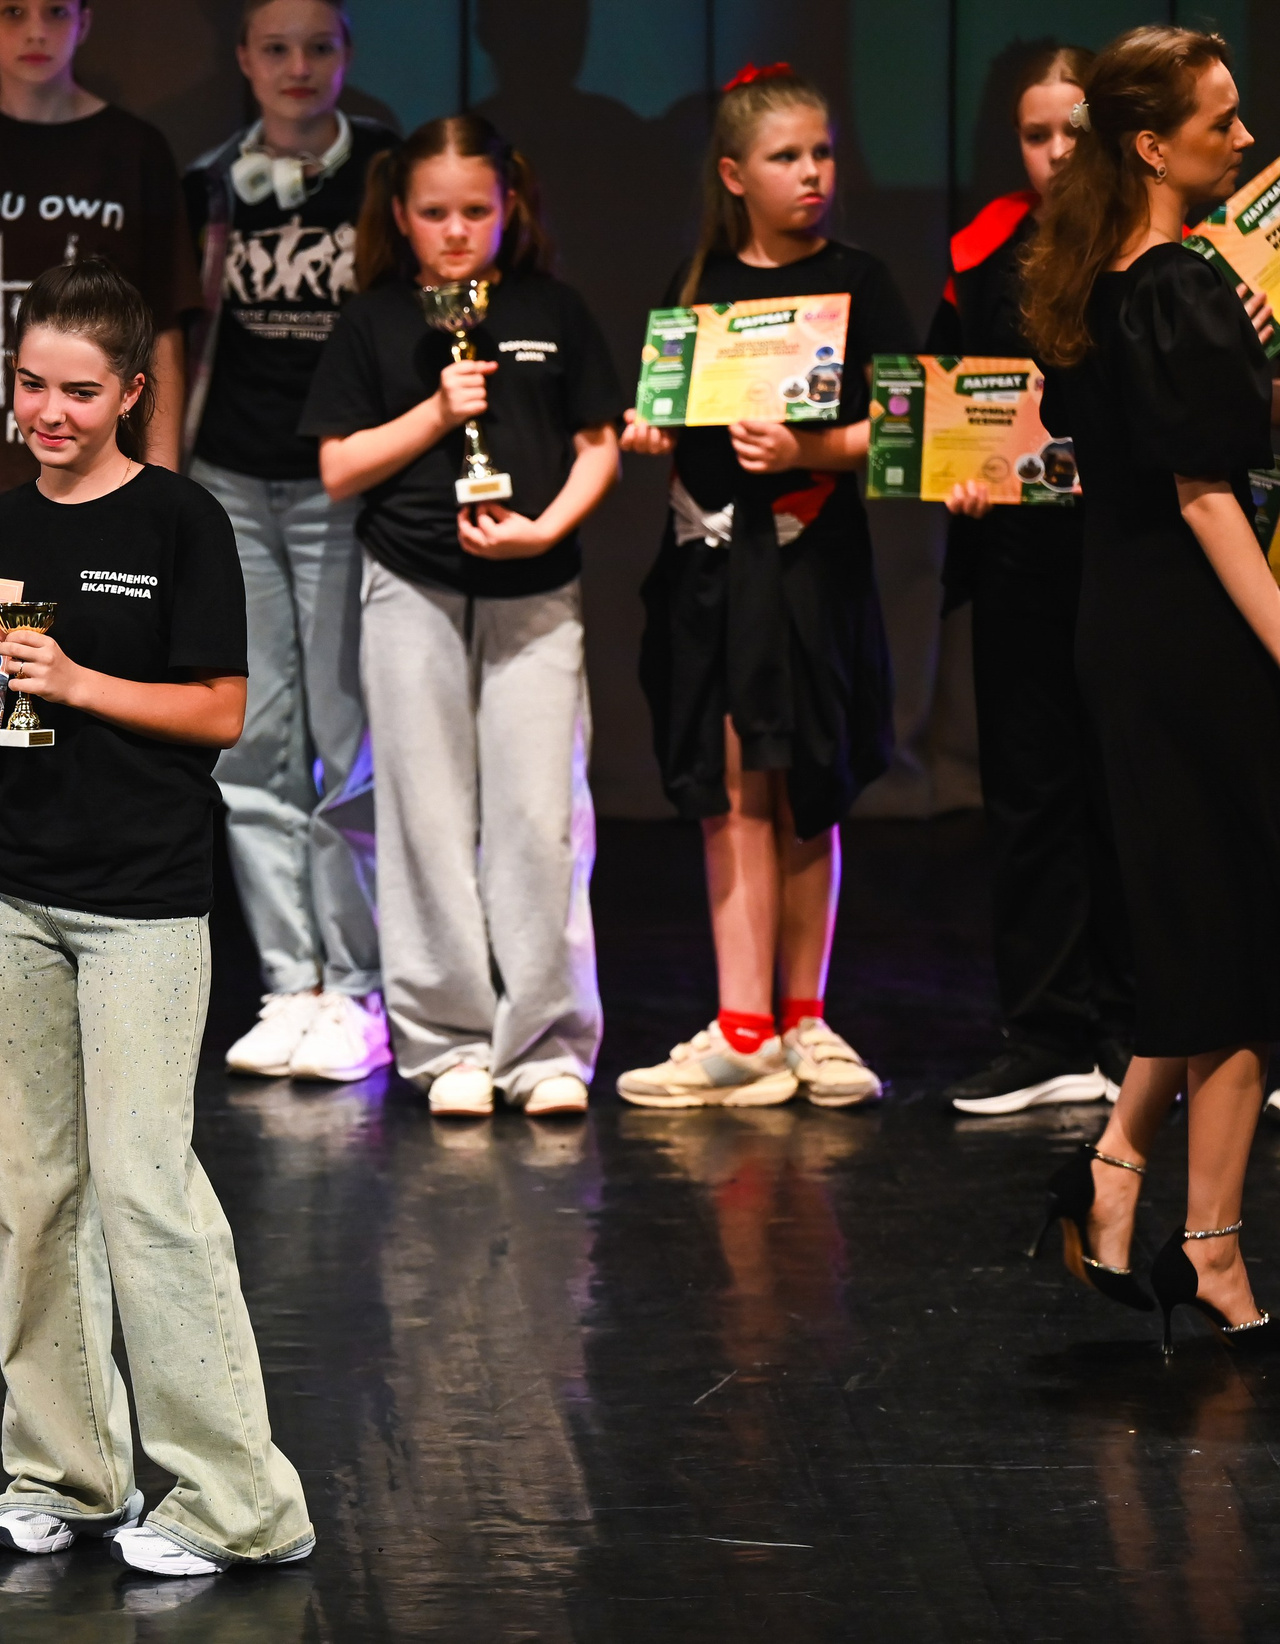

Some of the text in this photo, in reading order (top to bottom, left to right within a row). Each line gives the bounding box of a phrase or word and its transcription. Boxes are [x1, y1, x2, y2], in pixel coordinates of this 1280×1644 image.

[38, 193, 125, 231] own
[80, 570, 158, 586] СТЕПАНЕНКО
[81, 582, 151, 599] ЕКАТЕРИНА
